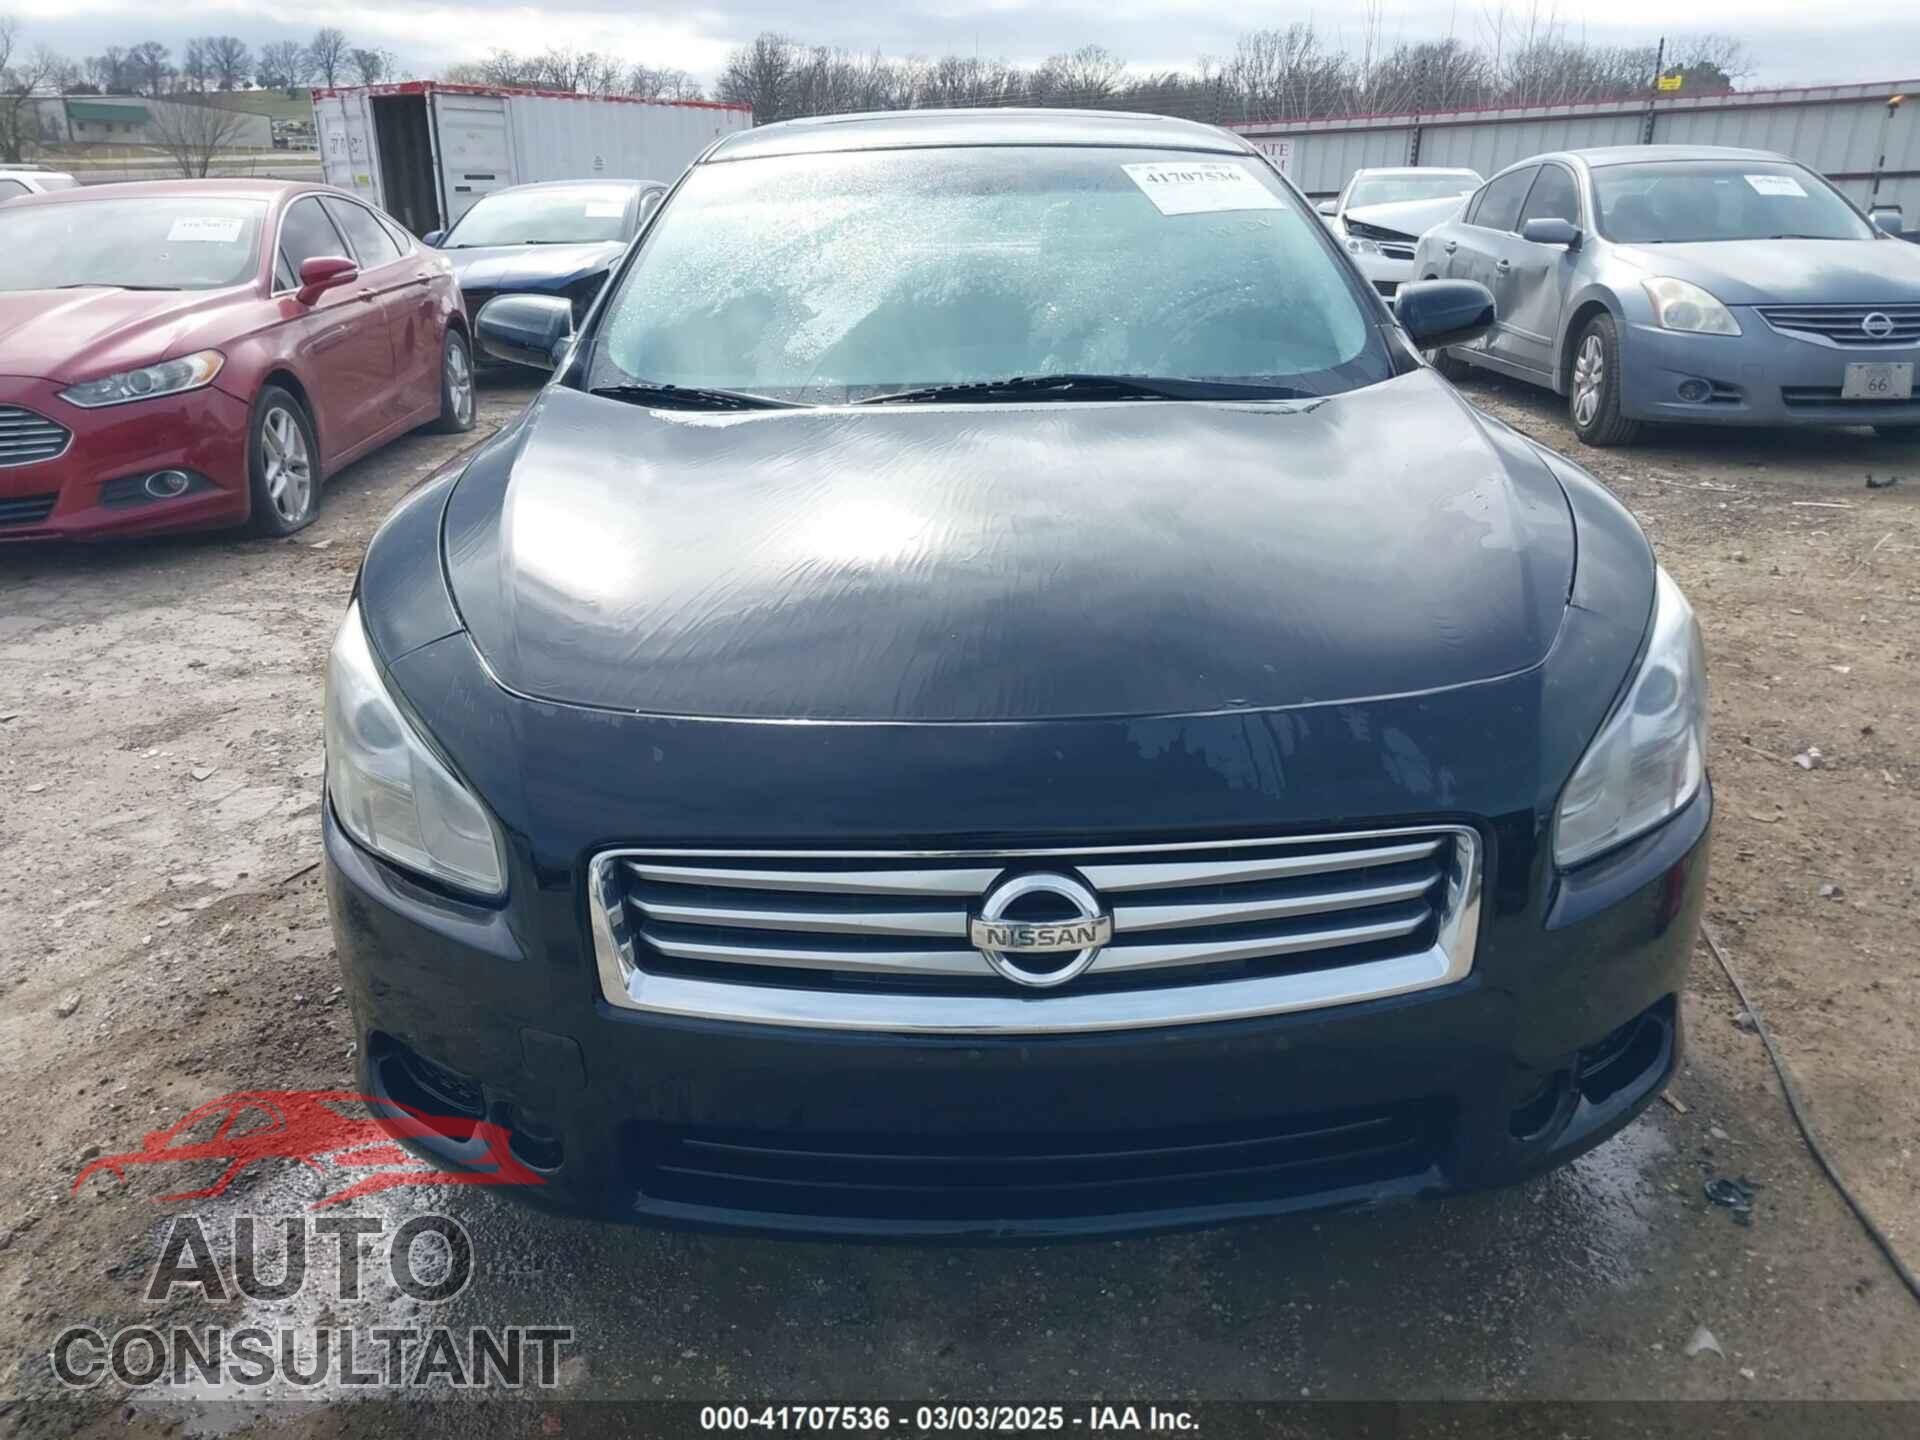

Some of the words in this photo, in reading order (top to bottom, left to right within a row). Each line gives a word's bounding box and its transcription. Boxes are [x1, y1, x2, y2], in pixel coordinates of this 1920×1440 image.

[1145, 171, 1241, 184] 41707536
[1867, 377, 1888, 392] 66
[987, 926, 1097, 946] NISSAN
